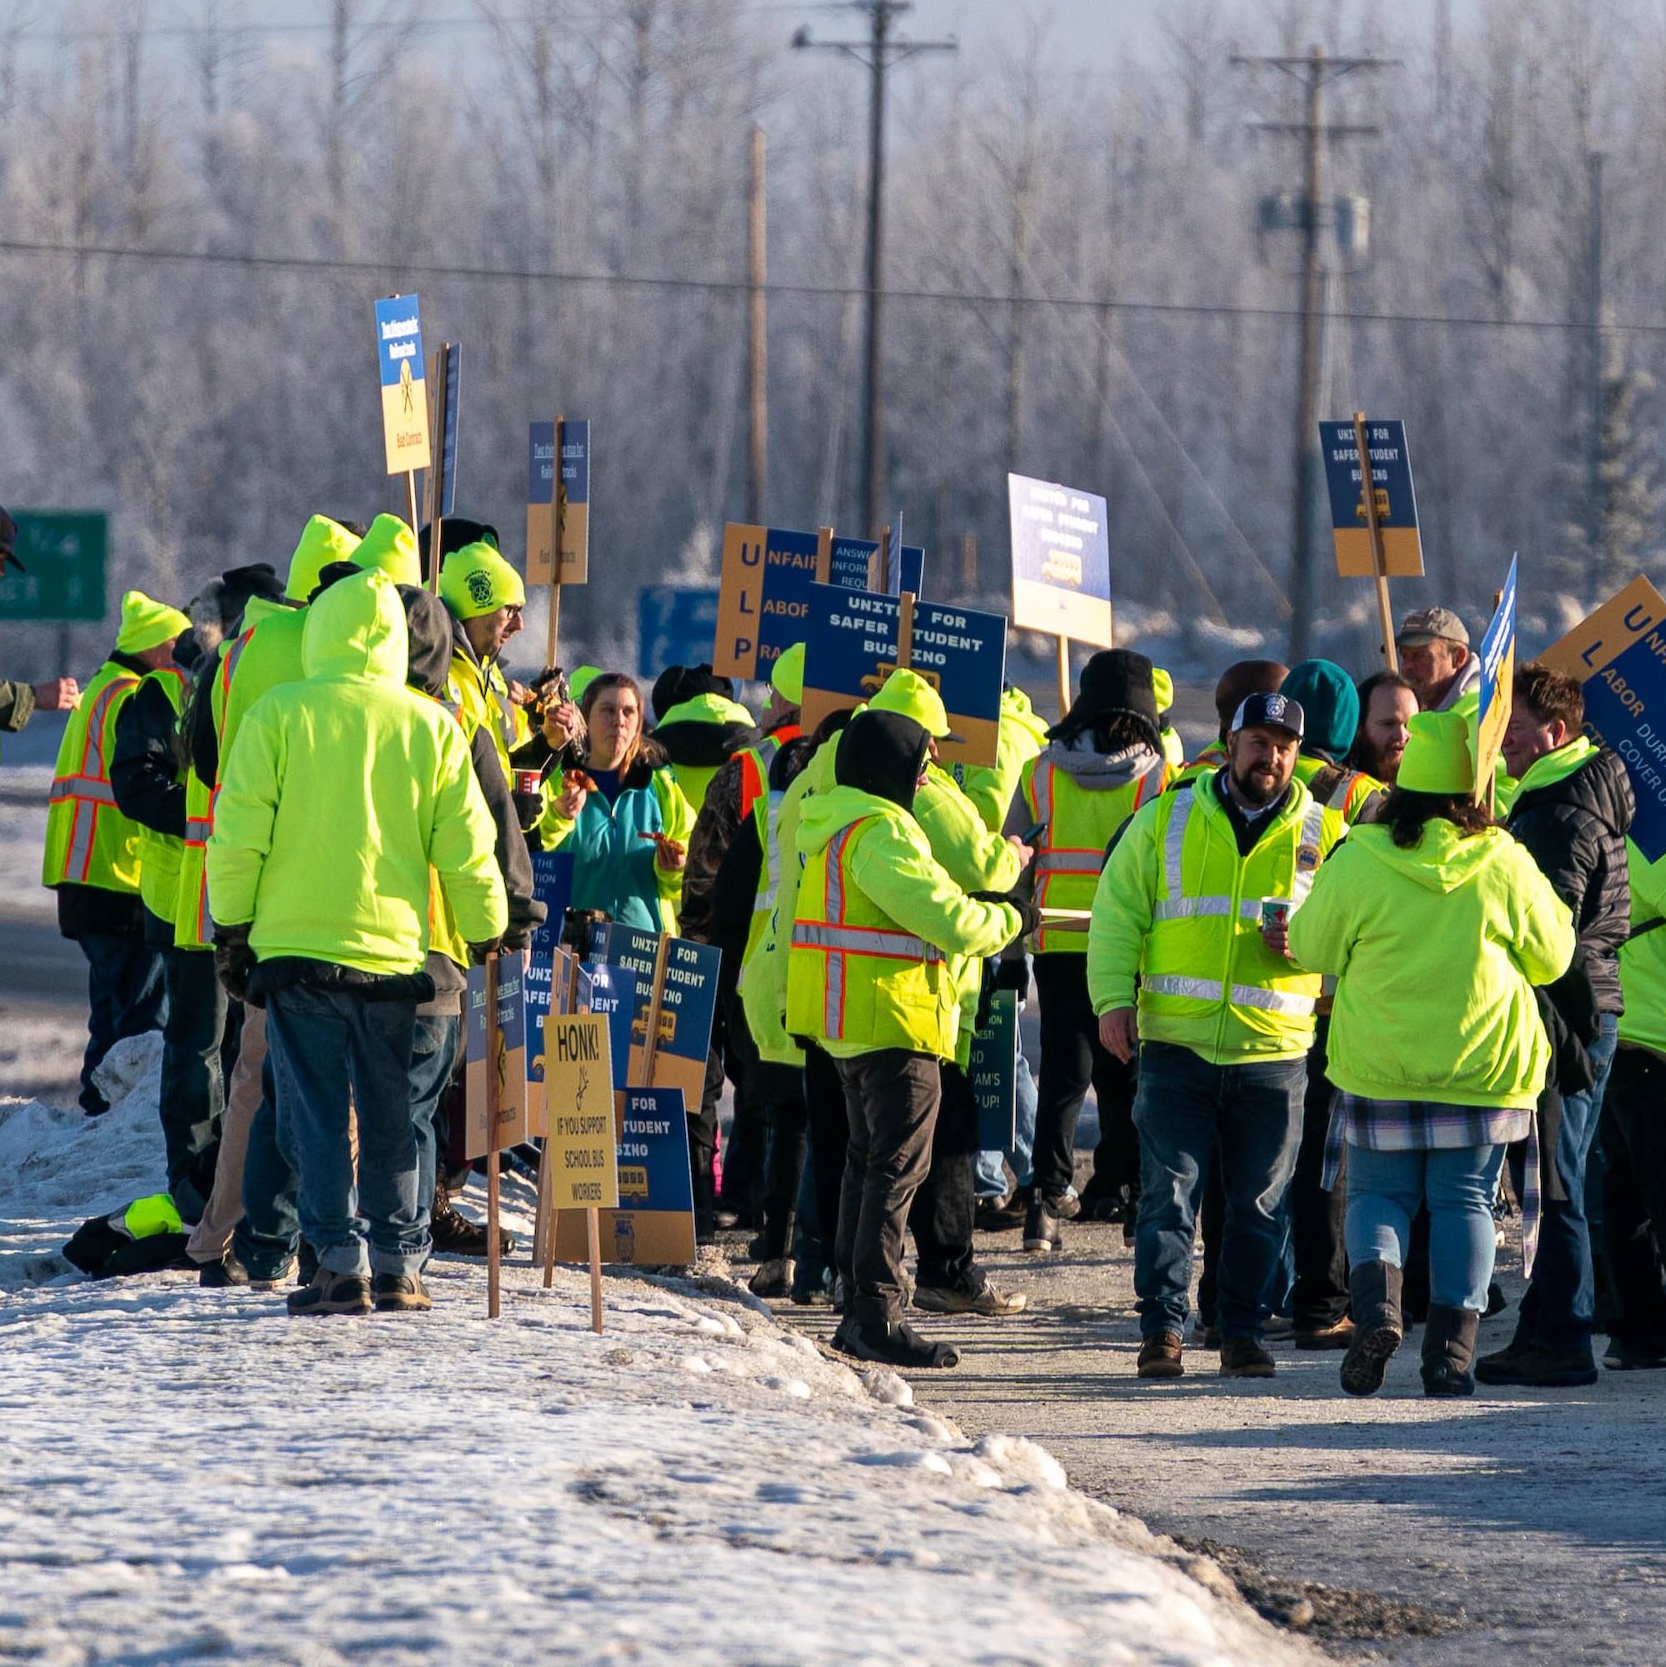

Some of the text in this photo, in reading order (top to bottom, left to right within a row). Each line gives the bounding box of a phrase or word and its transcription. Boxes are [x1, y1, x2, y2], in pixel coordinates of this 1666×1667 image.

[1373, 428, 1389, 440] FOR
[1369, 448, 1399, 460] TUDENT
[1351, 469, 1388, 481] BUING
[836, 546, 872, 559] ANSWE
[930, 611, 967, 629] FOR
[829, 614, 984, 653] SAFER TUDENT
[863, 640, 947, 666] BUSING
[1618, 738, 1663, 791] COVER
[537, 859, 554, 869] THE
[677, 947, 698, 964] FOR
[619, 955, 705, 988] SAFER TUDENT
[636, 981, 683, 1005] BUSING
[557, 1024, 600, 1062] HONK!
[631, 1098, 657, 1111] FOR
[981, 1095, 1000, 1109] UP!
[557, 1116, 607, 1135] IF YOU SUPPORT
[622, 1121, 671, 1135] TUDENT
[564, 1149, 605, 1169] SCHOOL BUS
[571, 1183, 602, 1201] WORKERS
